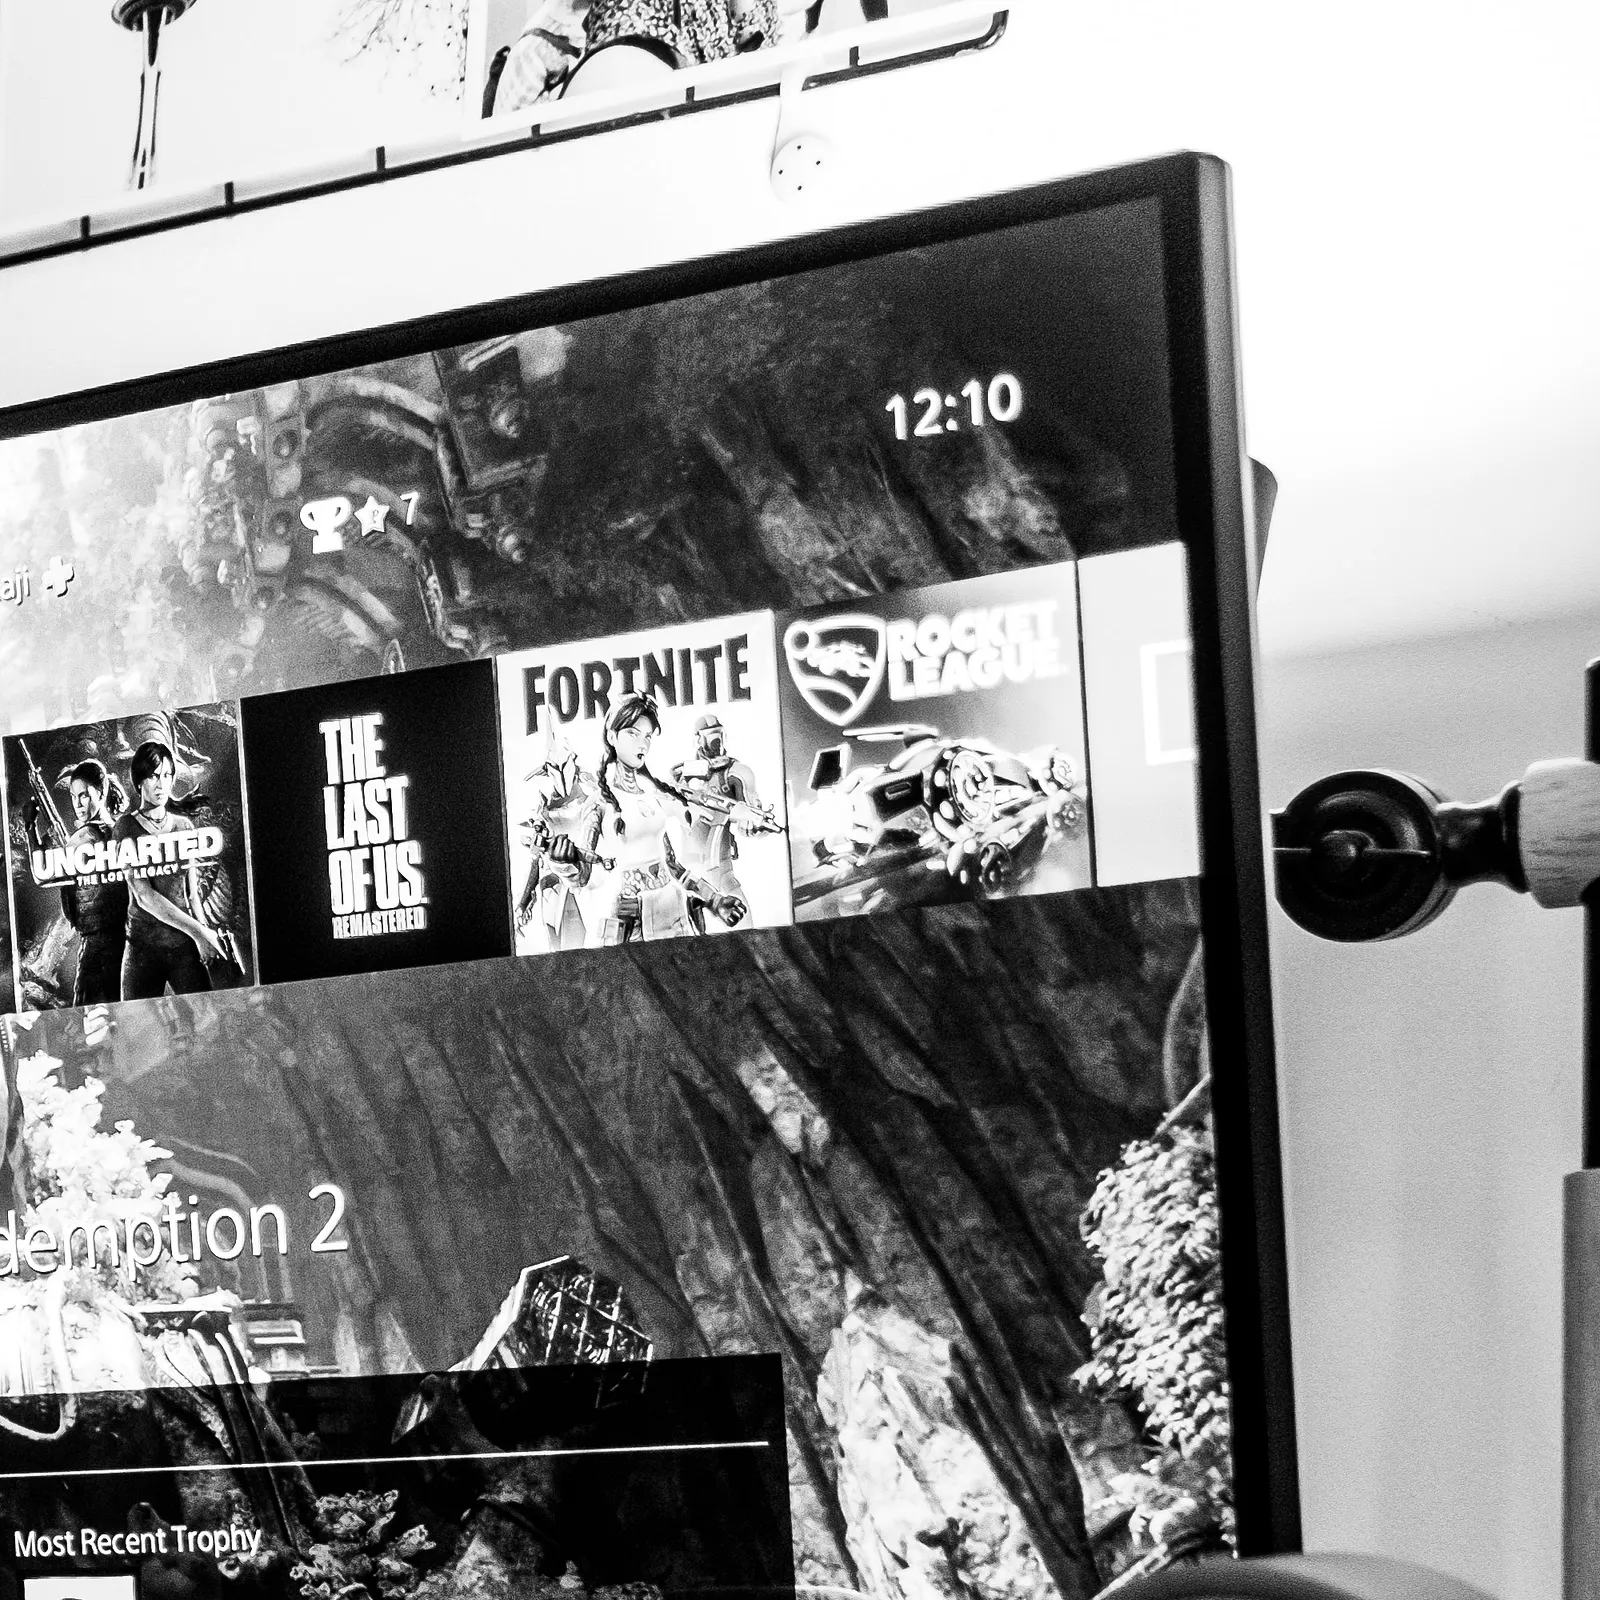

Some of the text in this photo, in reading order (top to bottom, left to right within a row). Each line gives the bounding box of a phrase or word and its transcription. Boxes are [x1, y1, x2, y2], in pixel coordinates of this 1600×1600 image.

[885, 372, 1023, 441] 12:10
[400, 490, 420, 528] 7
[886, 600, 1058, 662] ROCKET
[522, 631, 752, 736] FORTNITE
[888, 641, 1062, 702] LEAGUE
[318, 711, 387, 785] THE
[322, 774, 409, 851] LAST
[32, 826, 224, 881] UNCHARTED
[76, 863, 179, 887] THE LOST LEGACY
[328, 839, 423, 915] OF US
[331, 905, 427, 940] REMASTERED
[309, 1181, 350, 1254] 2
[13, 1525, 262, 1560] Most Recent Trophy
